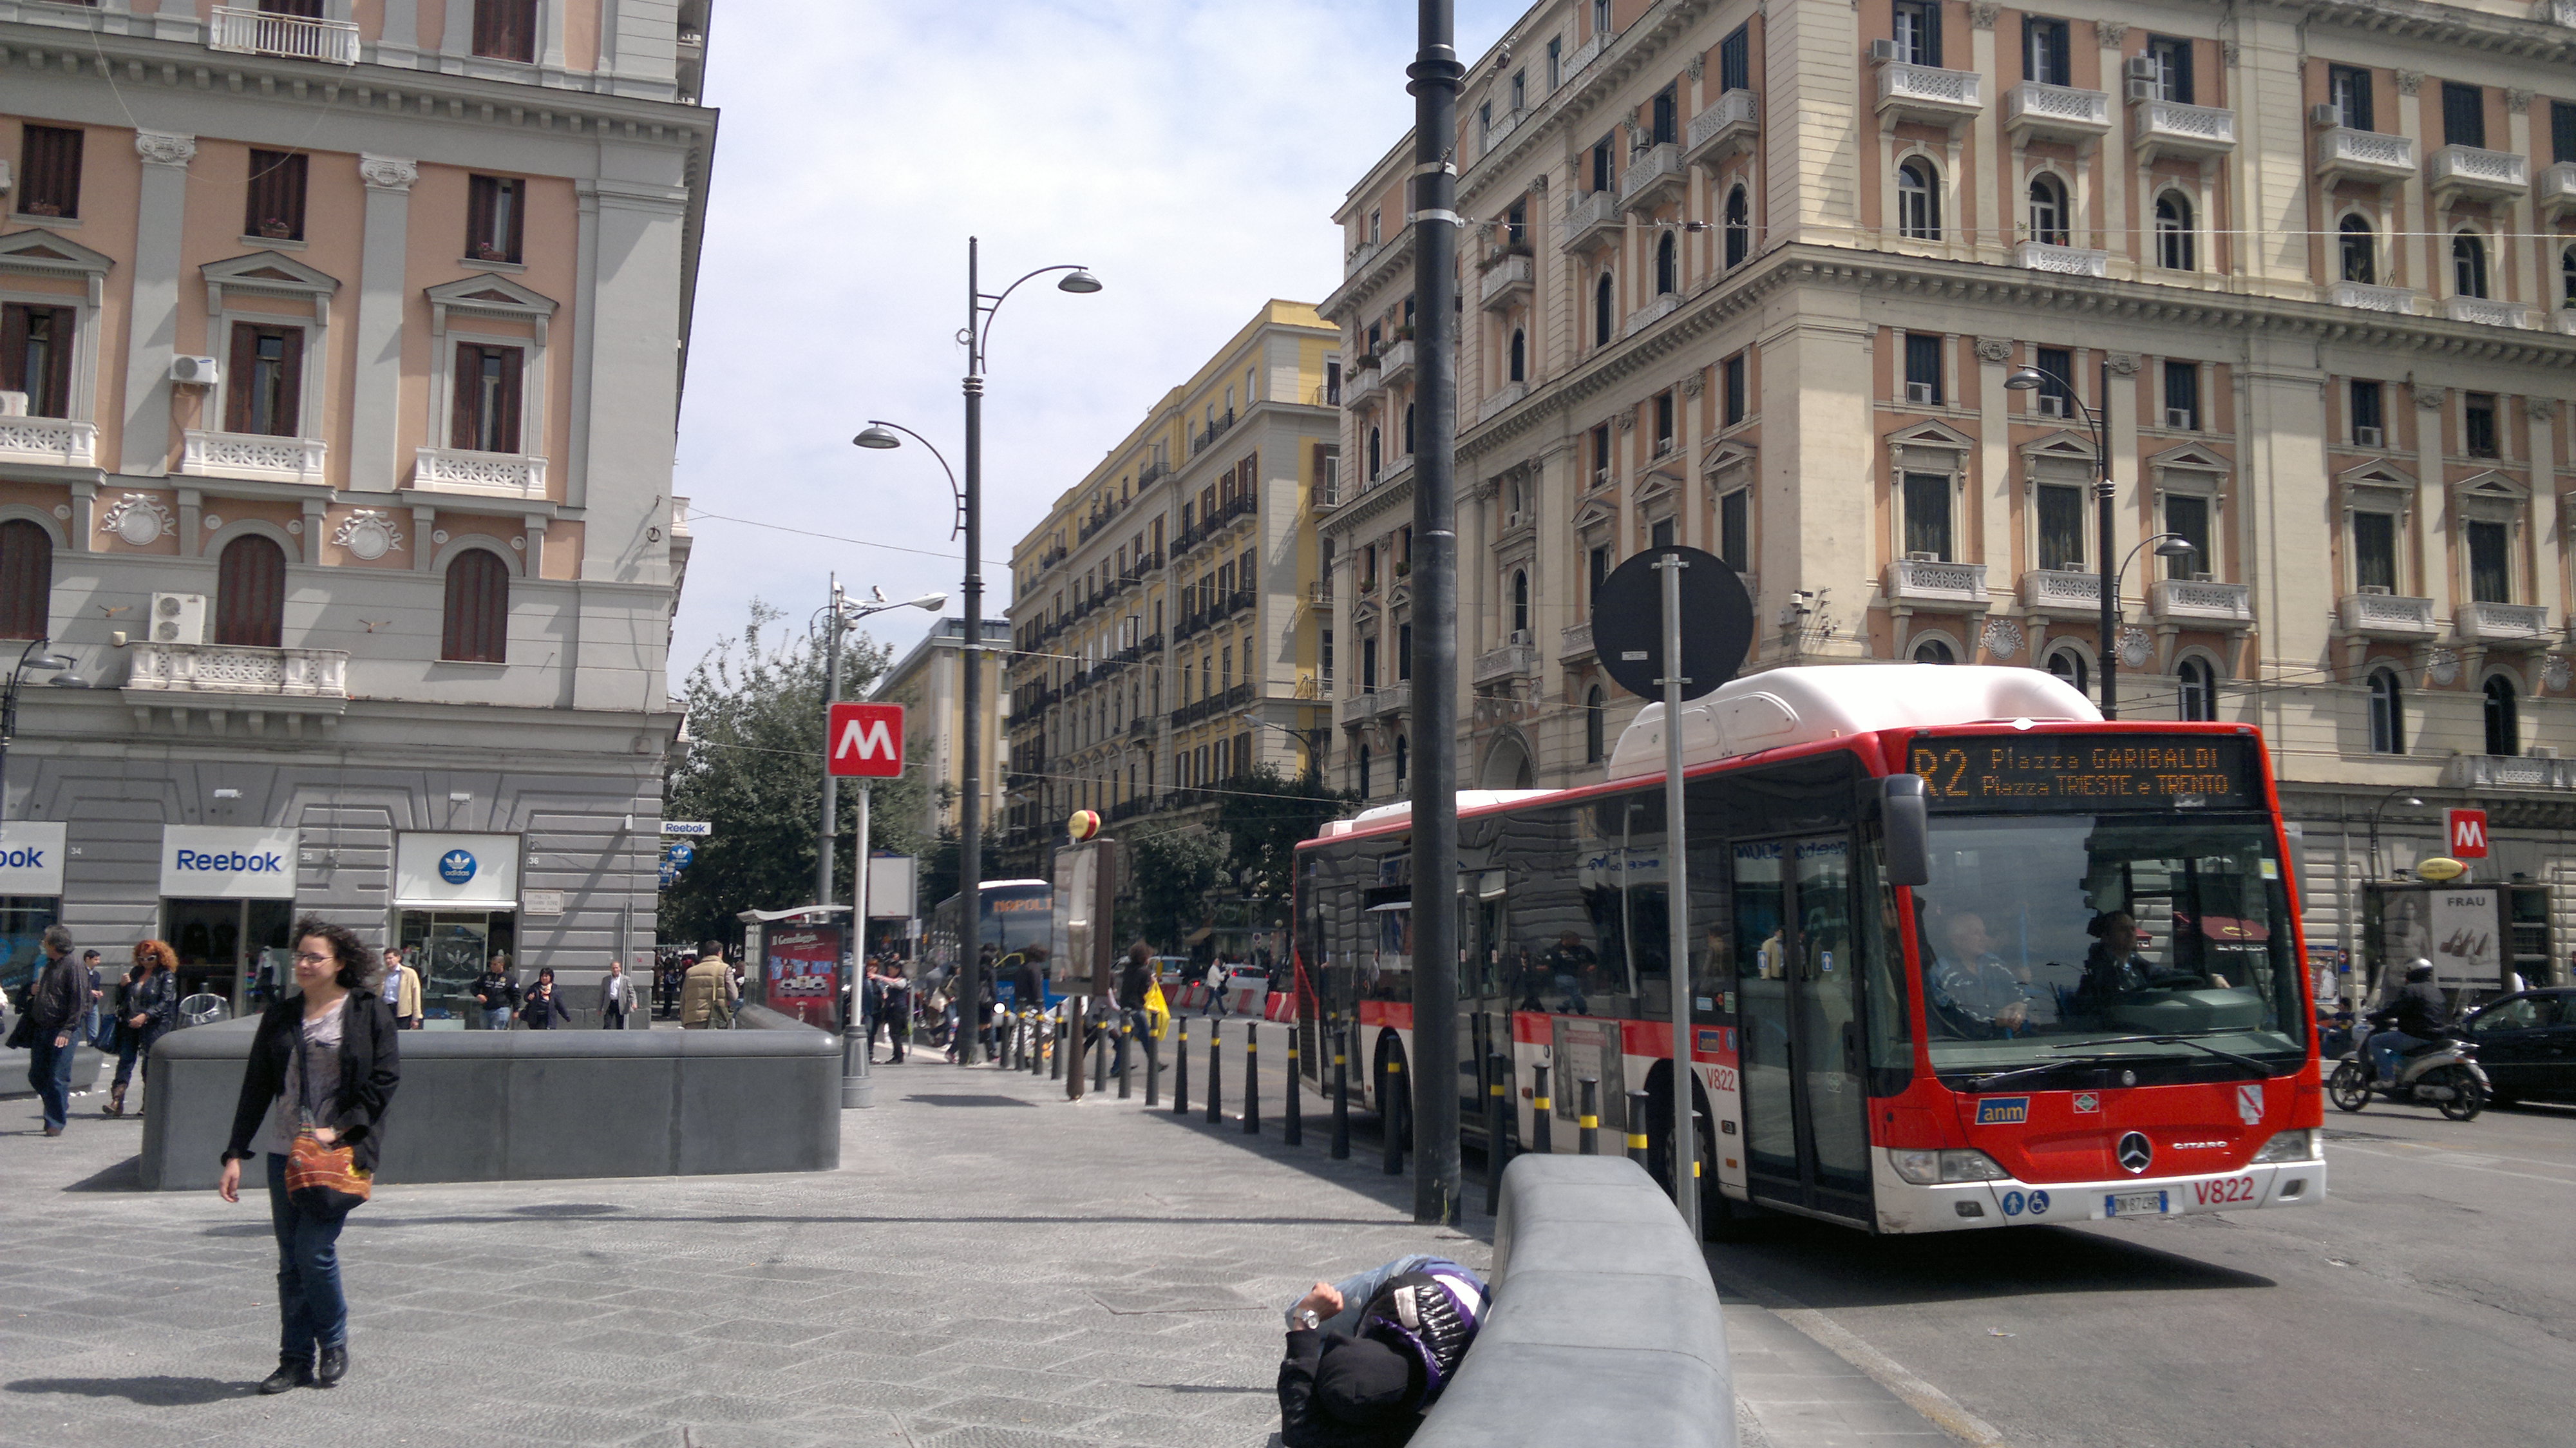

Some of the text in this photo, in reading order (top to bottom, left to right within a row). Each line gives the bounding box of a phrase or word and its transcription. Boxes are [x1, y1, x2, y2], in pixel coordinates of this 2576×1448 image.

[835, 719, 896, 760] M
[1915, 748, 2217, 796] R2 Piazza GARIBALDI
[1982, 774, 2229, 795] Piazza TRIESTE e TRENTO
[665, 823, 706, 832] Reebok
[2457, 821, 2485, 847] M
[177, 850, 282, 872] Reebok
[2448, 897, 2486, 906] FRAU
[1706, 1067, 1735, 1092] V822
[1984, 1107, 2023, 1121] anm
[2173, 1141, 2228, 1150] CITARO
[2194, 1176, 2255, 1205] V822
